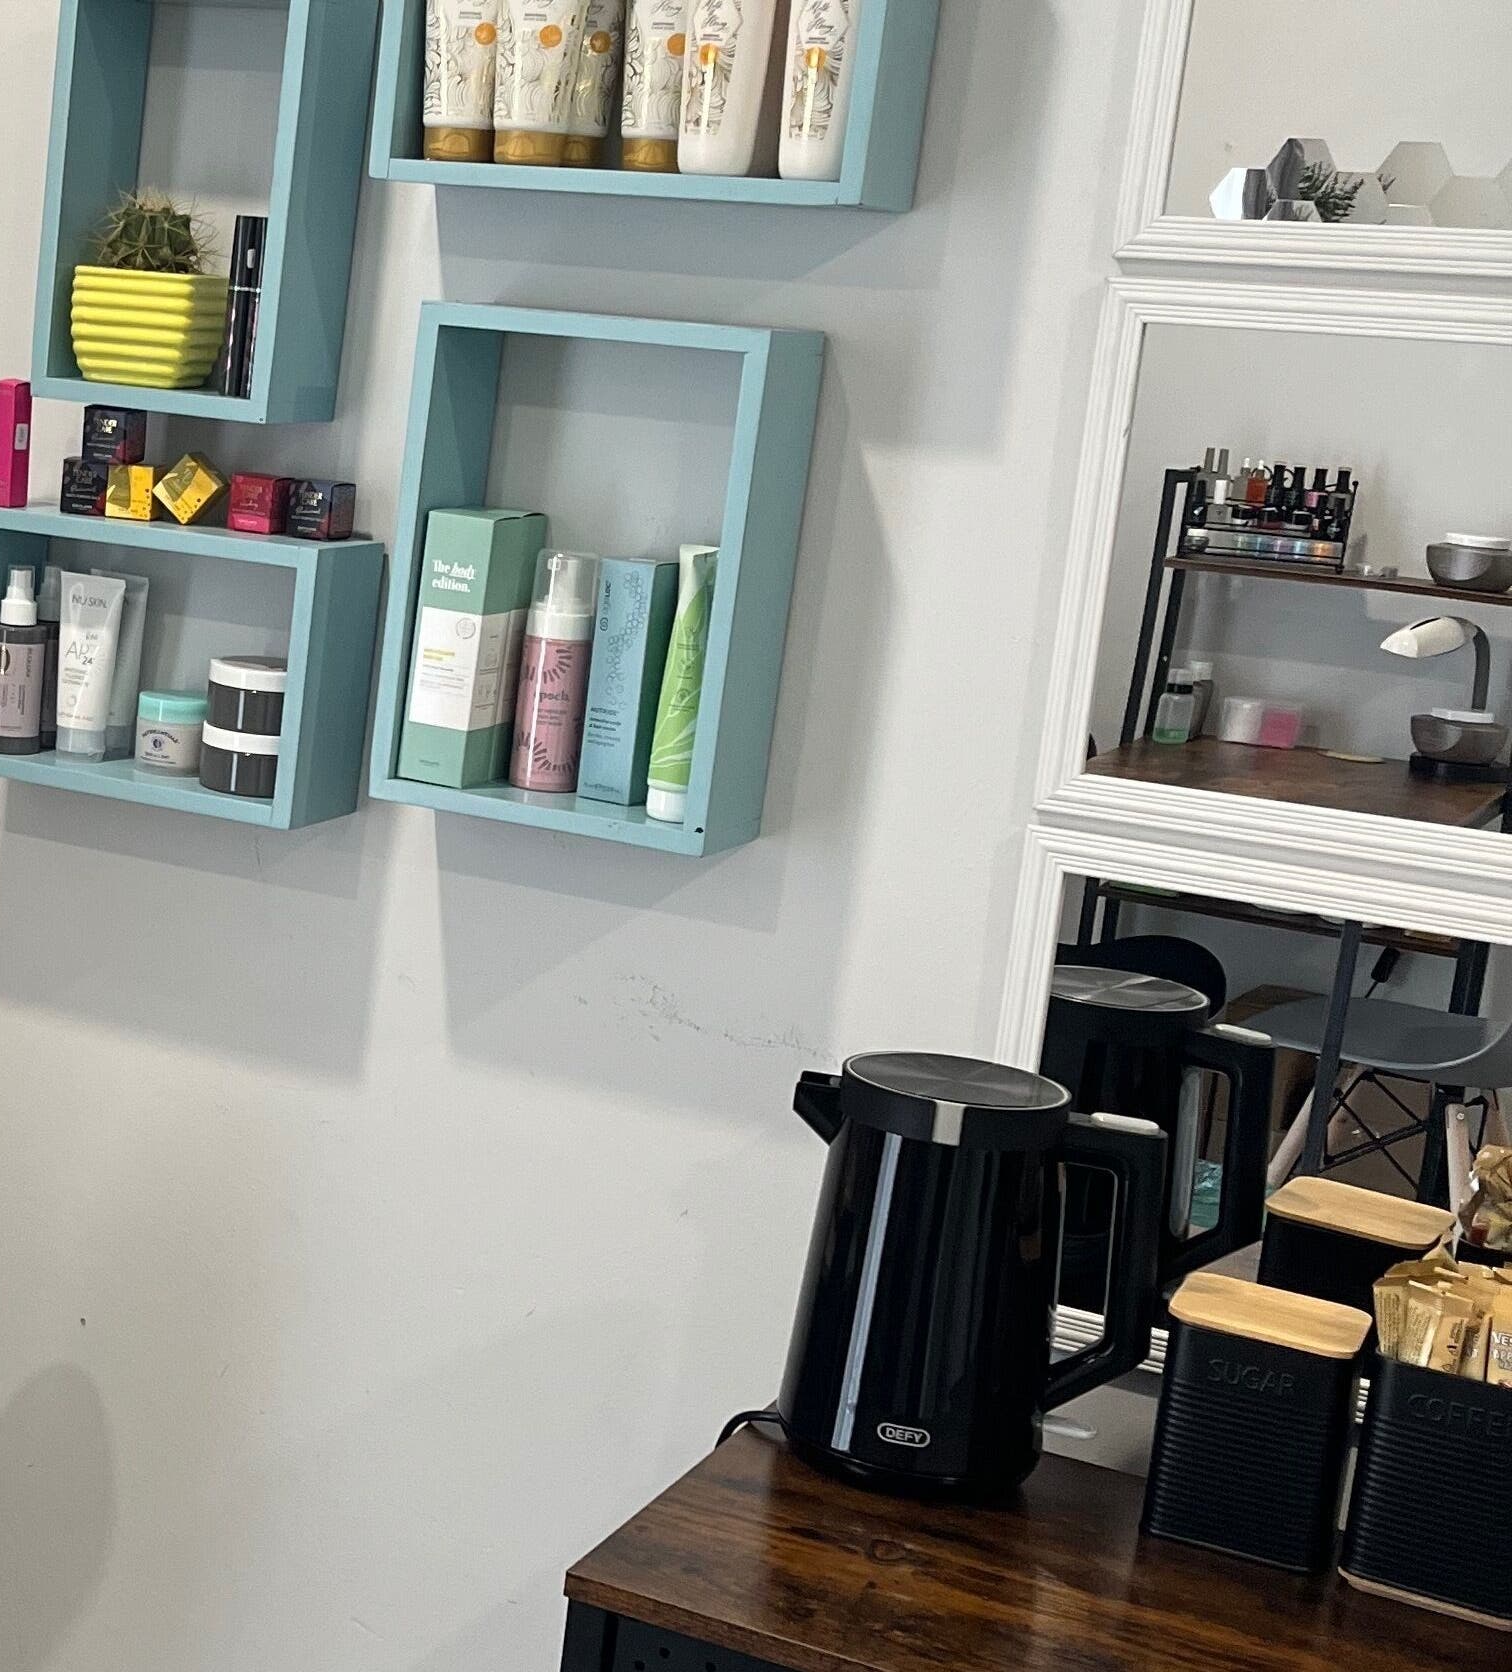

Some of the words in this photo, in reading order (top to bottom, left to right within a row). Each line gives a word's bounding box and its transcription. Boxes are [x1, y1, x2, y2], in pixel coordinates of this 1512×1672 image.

[431, 559, 450, 574] The
[450, 562, 476, 580] body
[431, 577, 471, 593] edition.
[1208, 1359, 1296, 1396] SUGAR
[1408, 1393, 1512, 1438] COFFE
[885, 1427, 923, 1443] DEFY
